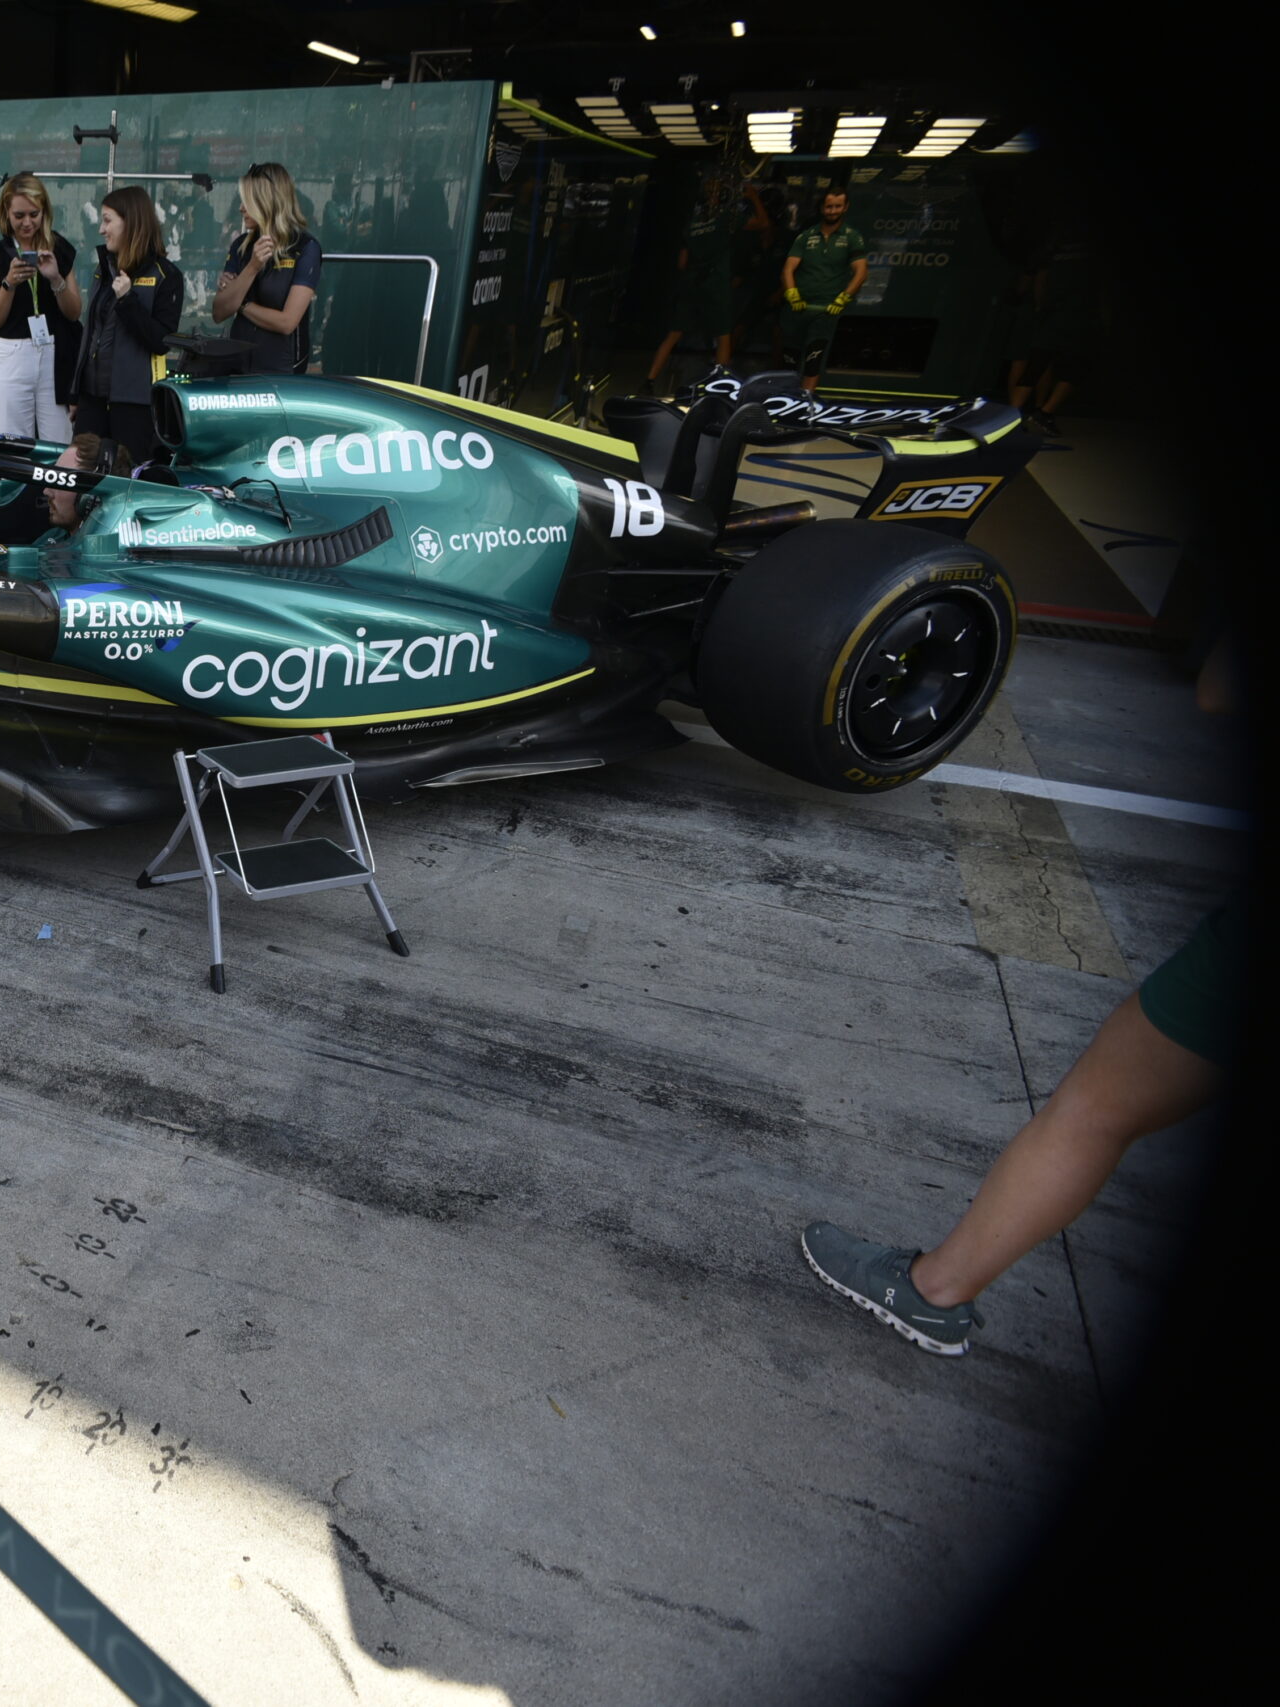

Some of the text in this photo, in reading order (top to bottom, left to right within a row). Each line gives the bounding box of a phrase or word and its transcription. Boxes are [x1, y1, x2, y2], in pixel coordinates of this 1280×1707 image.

[867, 251, 950, 267] aramco
[472, 275, 502, 306] aramco
[188, 393, 277, 411] BOMBARDIER
[267, 430, 494, 479] aramco
[32, 466, 77, 488] BOSS
[603, 477, 666, 539] 18
[883, 484, 984, 513] JCB
[144, 521, 257, 547] SentinelOne
[449, 521, 568, 553] crypto.com
[928, 562, 985, 583] PIRELLI
[64, 598, 185, 628] PERONI
[63, 628, 185, 640] NASTRO AZZURRO
[103, 641, 154, 661] 0.0%
[181, 619, 498, 711] cognizant
[364, 716, 454, 736] AstonMartin.com
[30, 1380, 63, 1411] 10
[82, 1410, 128, 1447] 20
